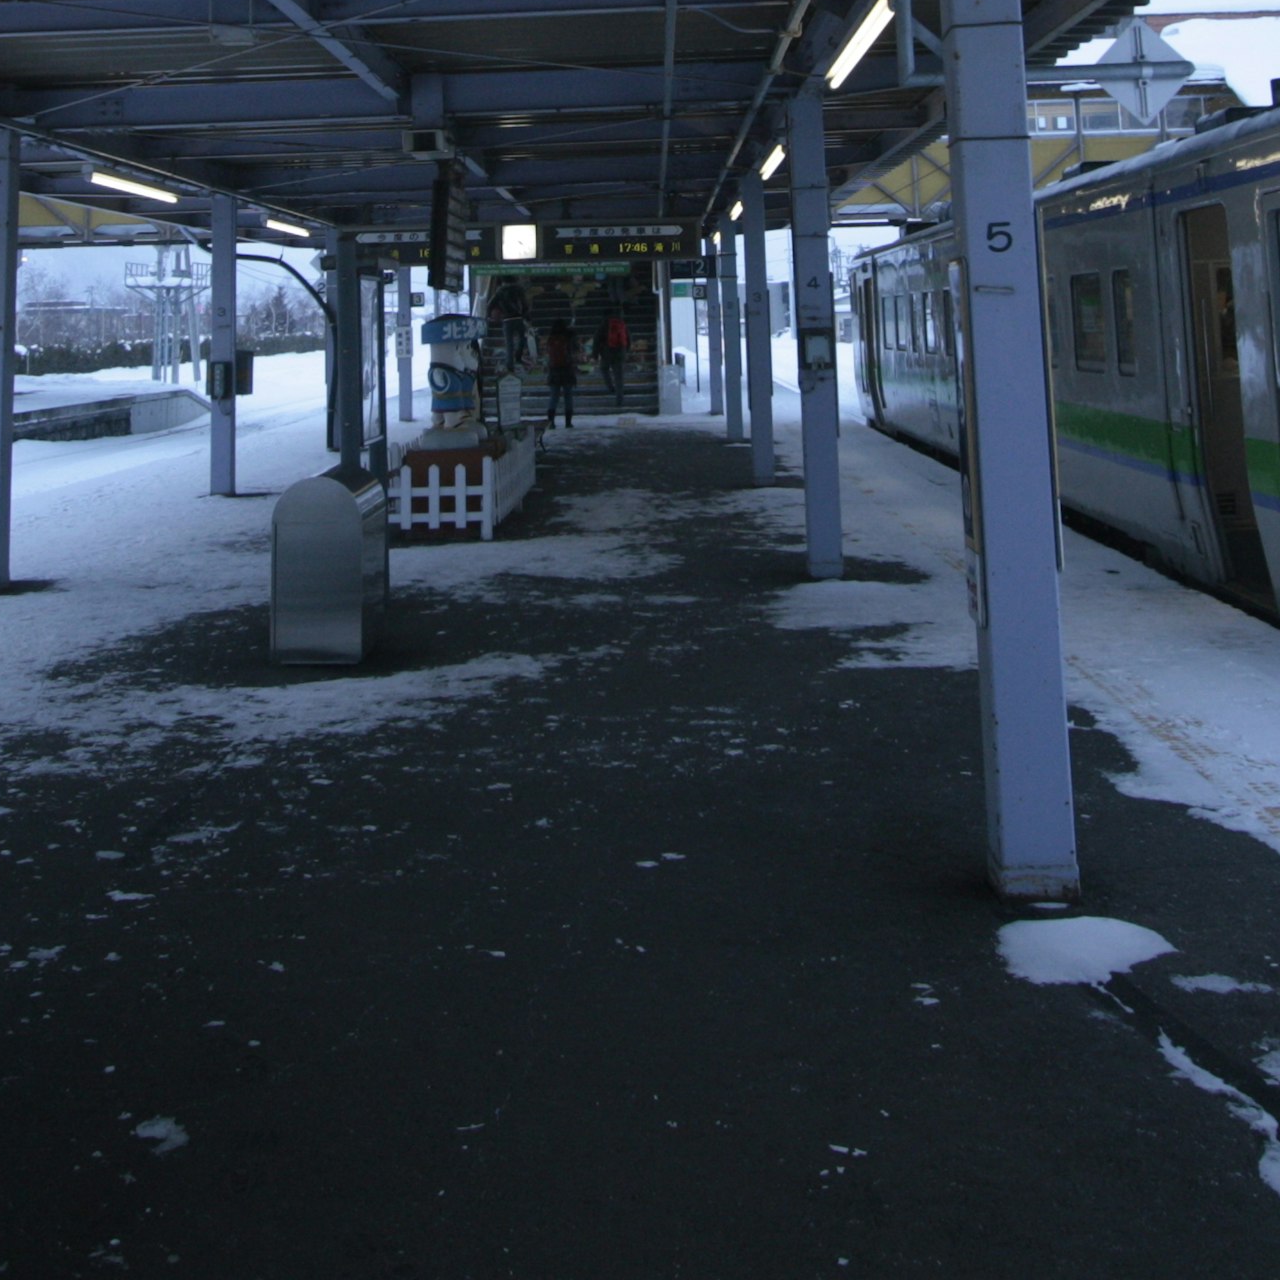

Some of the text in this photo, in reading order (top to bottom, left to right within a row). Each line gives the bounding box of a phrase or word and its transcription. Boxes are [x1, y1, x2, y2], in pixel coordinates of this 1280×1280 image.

[987, 222, 1012, 252] 5
[695, 260, 705, 274] 2
[317, 282, 326, 294] 2
[807, 276, 820, 288] 4
[695, 287, 703, 297] 2
